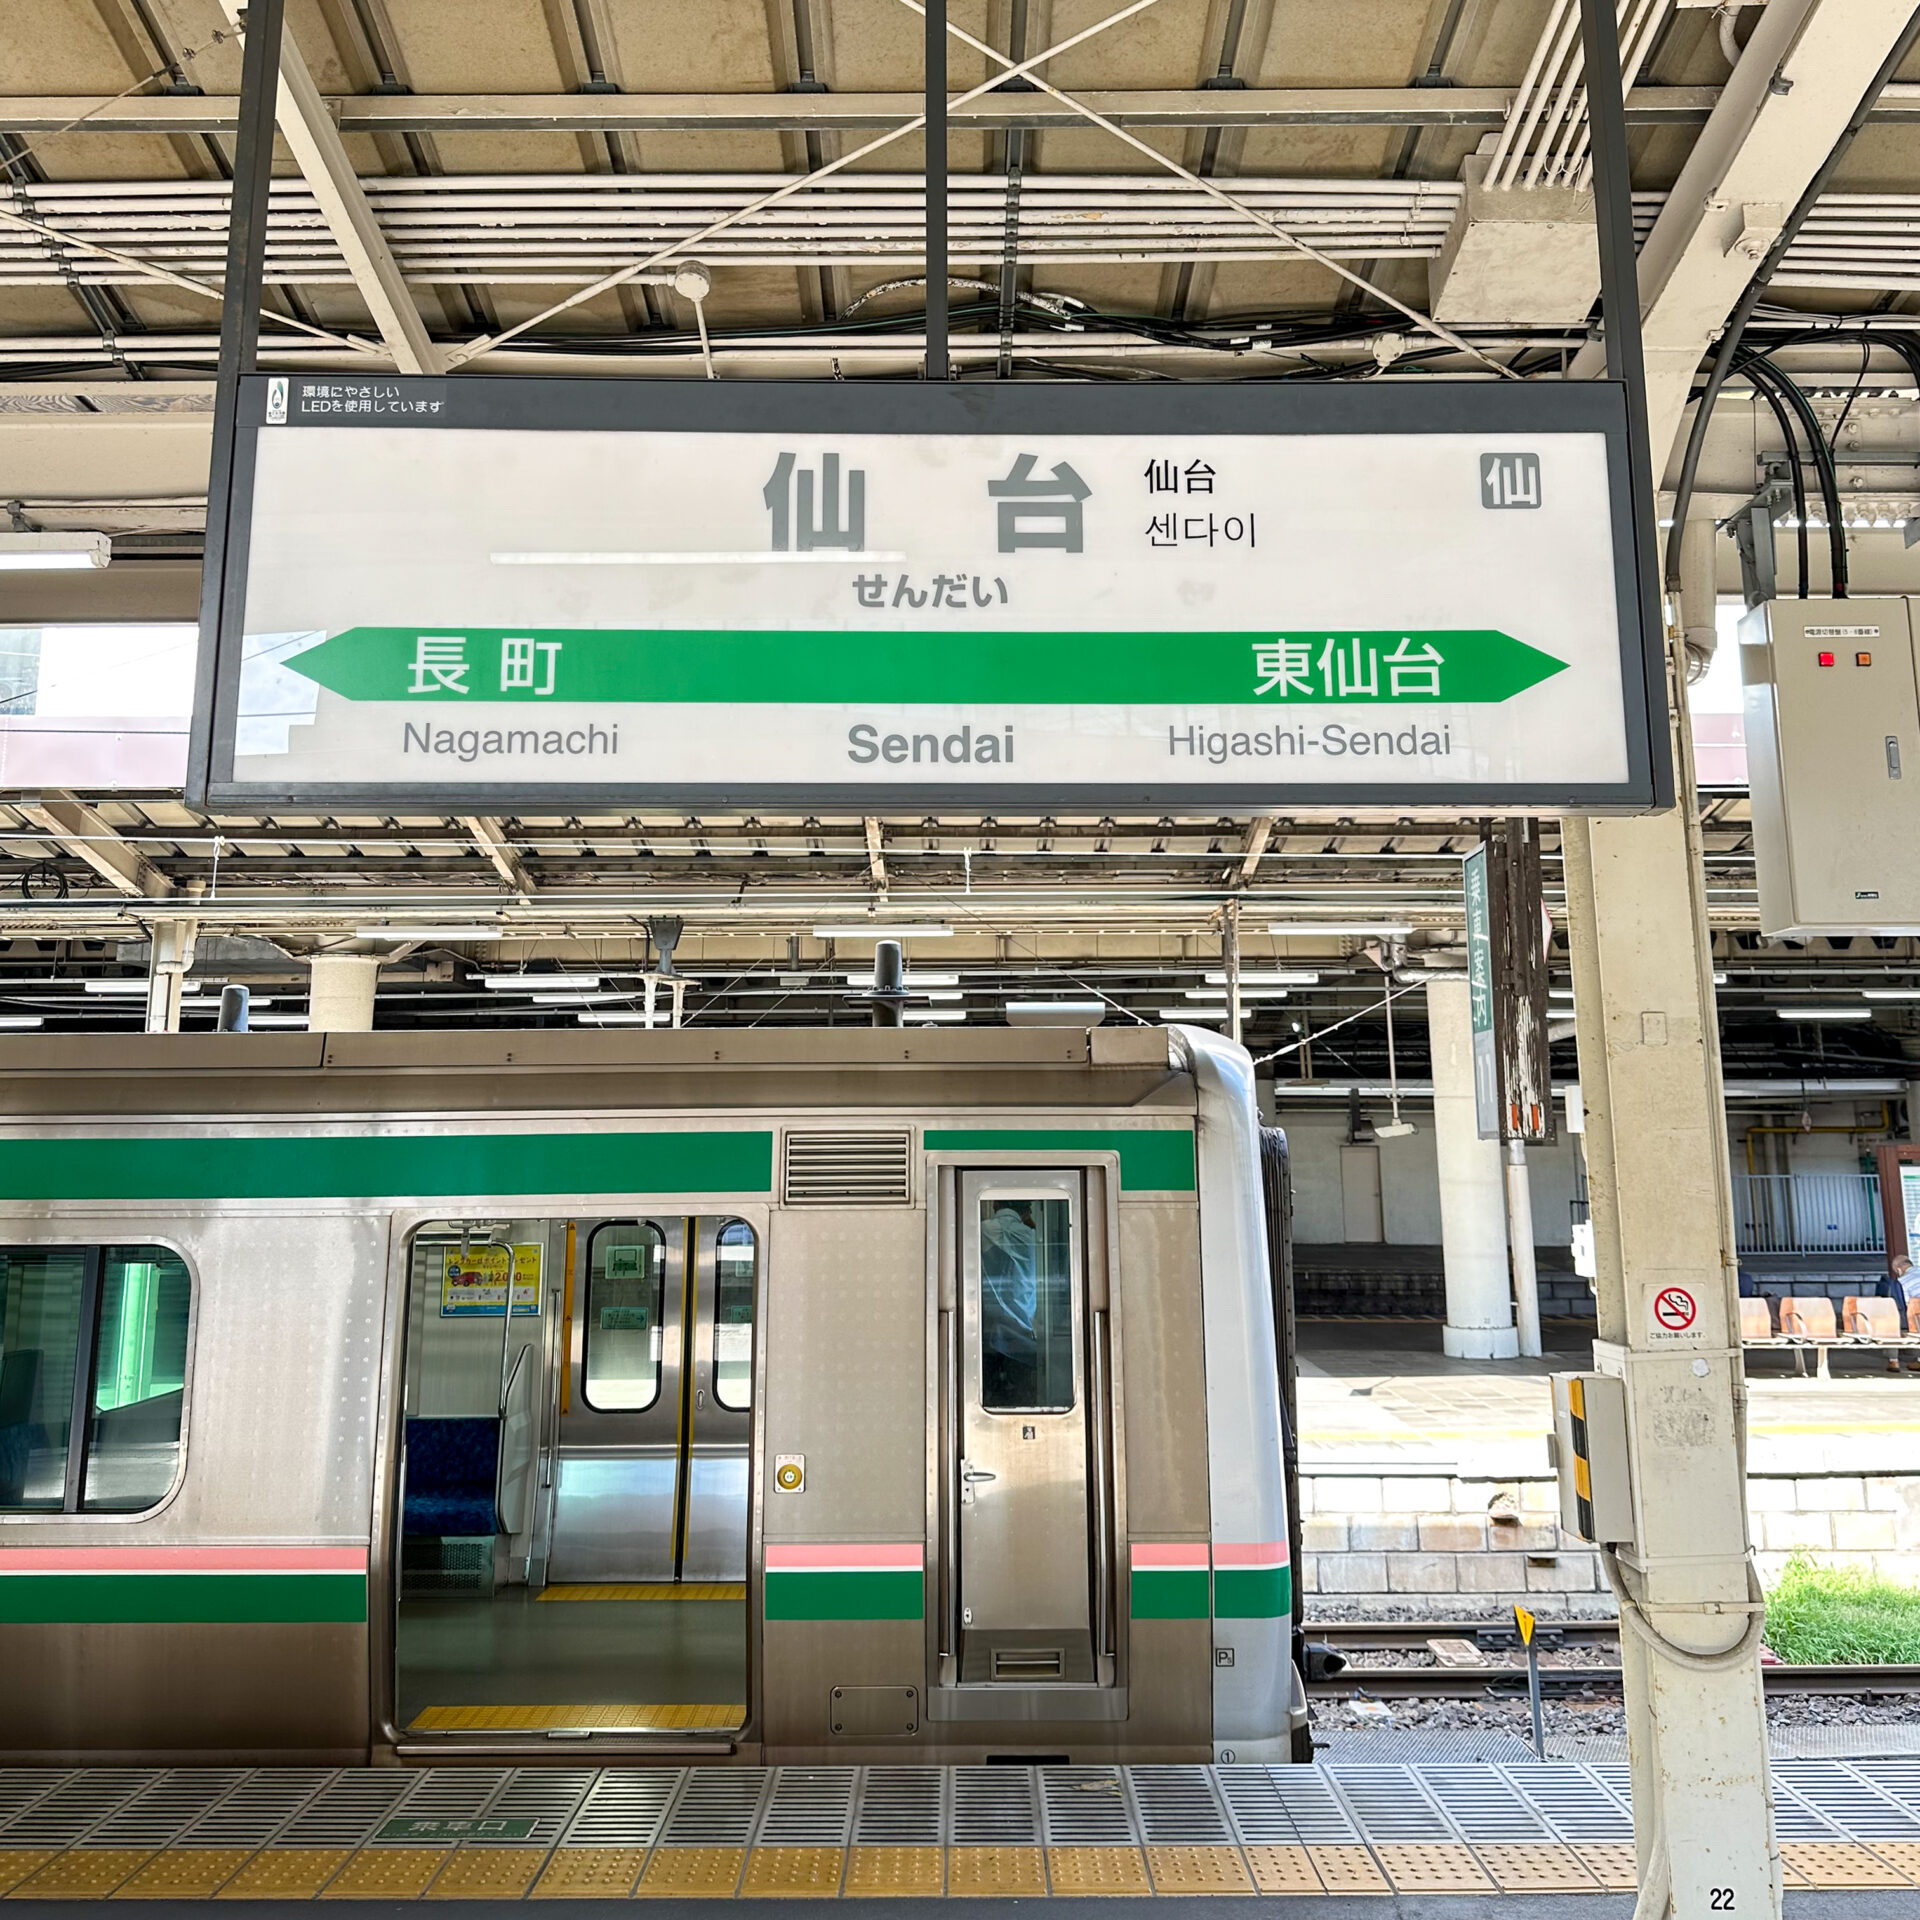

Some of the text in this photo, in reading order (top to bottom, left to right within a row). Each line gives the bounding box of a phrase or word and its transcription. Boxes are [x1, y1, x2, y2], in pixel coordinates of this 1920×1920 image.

[301, 399, 444, 413] LEDを使用しています
[302, 385, 400, 398] 環境にやさしい
[1144, 459, 1216, 495] 仙台
[1486, 459, 1537, 506] 仙
[762, 451, 1092, 554] 仙台
[1145, 512, 1258, 549] 센다이
[853, 574, 1008, 609] せんだい
[407, 636, 563, 696] 長町
[1252, 637, 1445, 698] 東仙台
[404, 722, 618, 763] Nagamachi
[848, 724, 1014, 764] Sendai
[1169, 723, 1451, 765] Higashi-Sendai
[1710, 1888, 1736, 1910] 22
